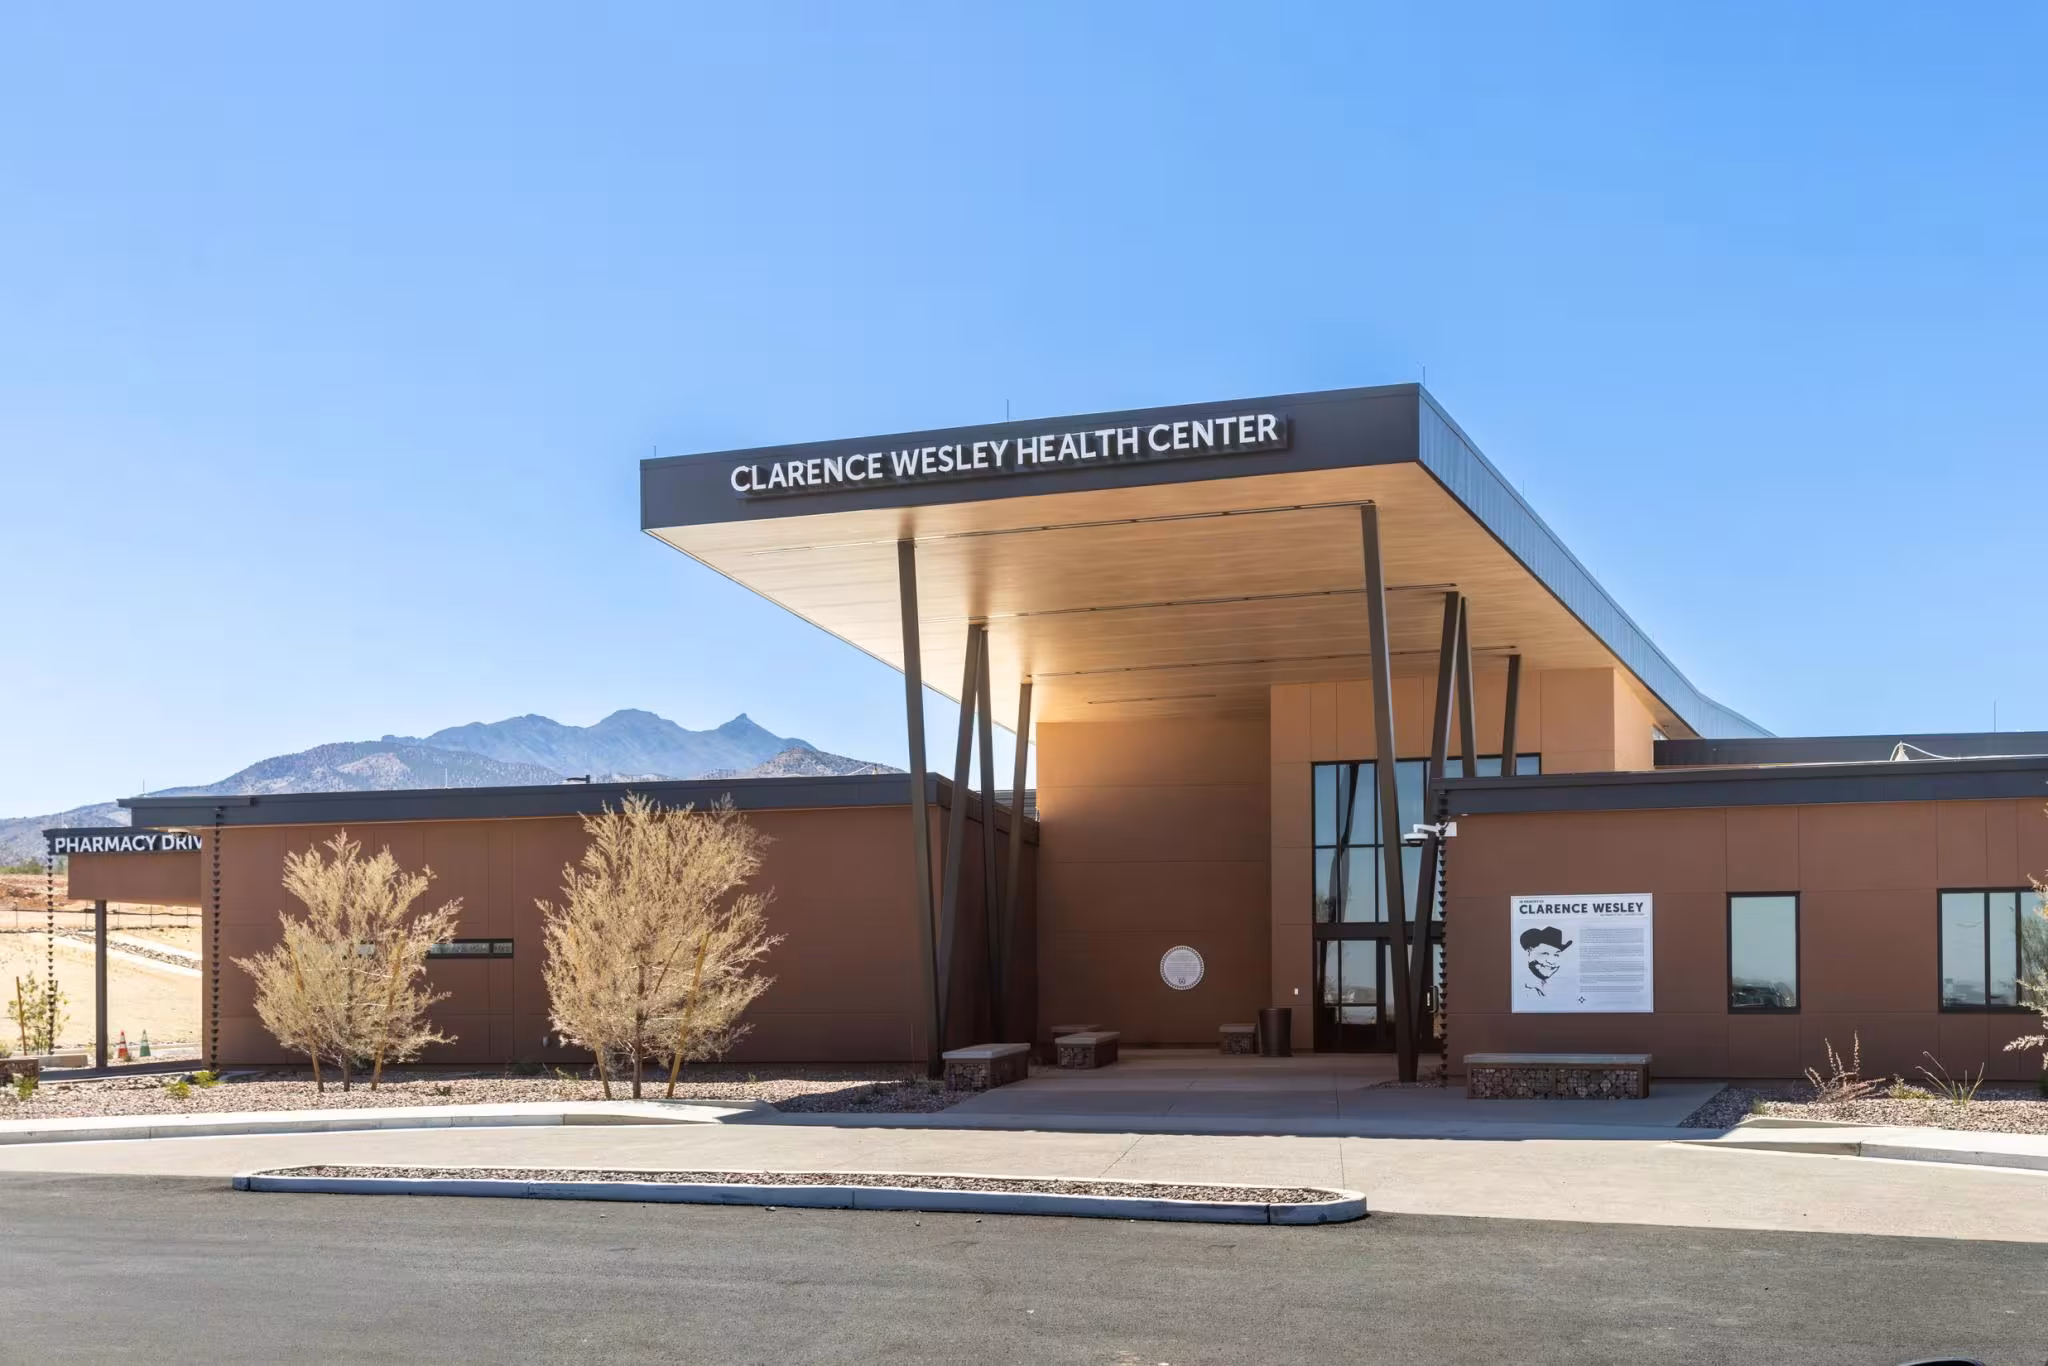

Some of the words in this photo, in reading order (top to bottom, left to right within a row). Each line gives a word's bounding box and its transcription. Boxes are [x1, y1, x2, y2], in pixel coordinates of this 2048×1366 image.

[730, 452, 884, 492] CLARENCE
[890, 439, 1009, 477] WESLEY
[1017, 426, 1138, 465] HEALTH
[1148, 413, 1279, 452] CENTER
[55, 835, 157, 853] PHARMACY
[1519, 903, 1588, 915] CLARENCE
[1592, 902, 1644, 913] WESLEY
